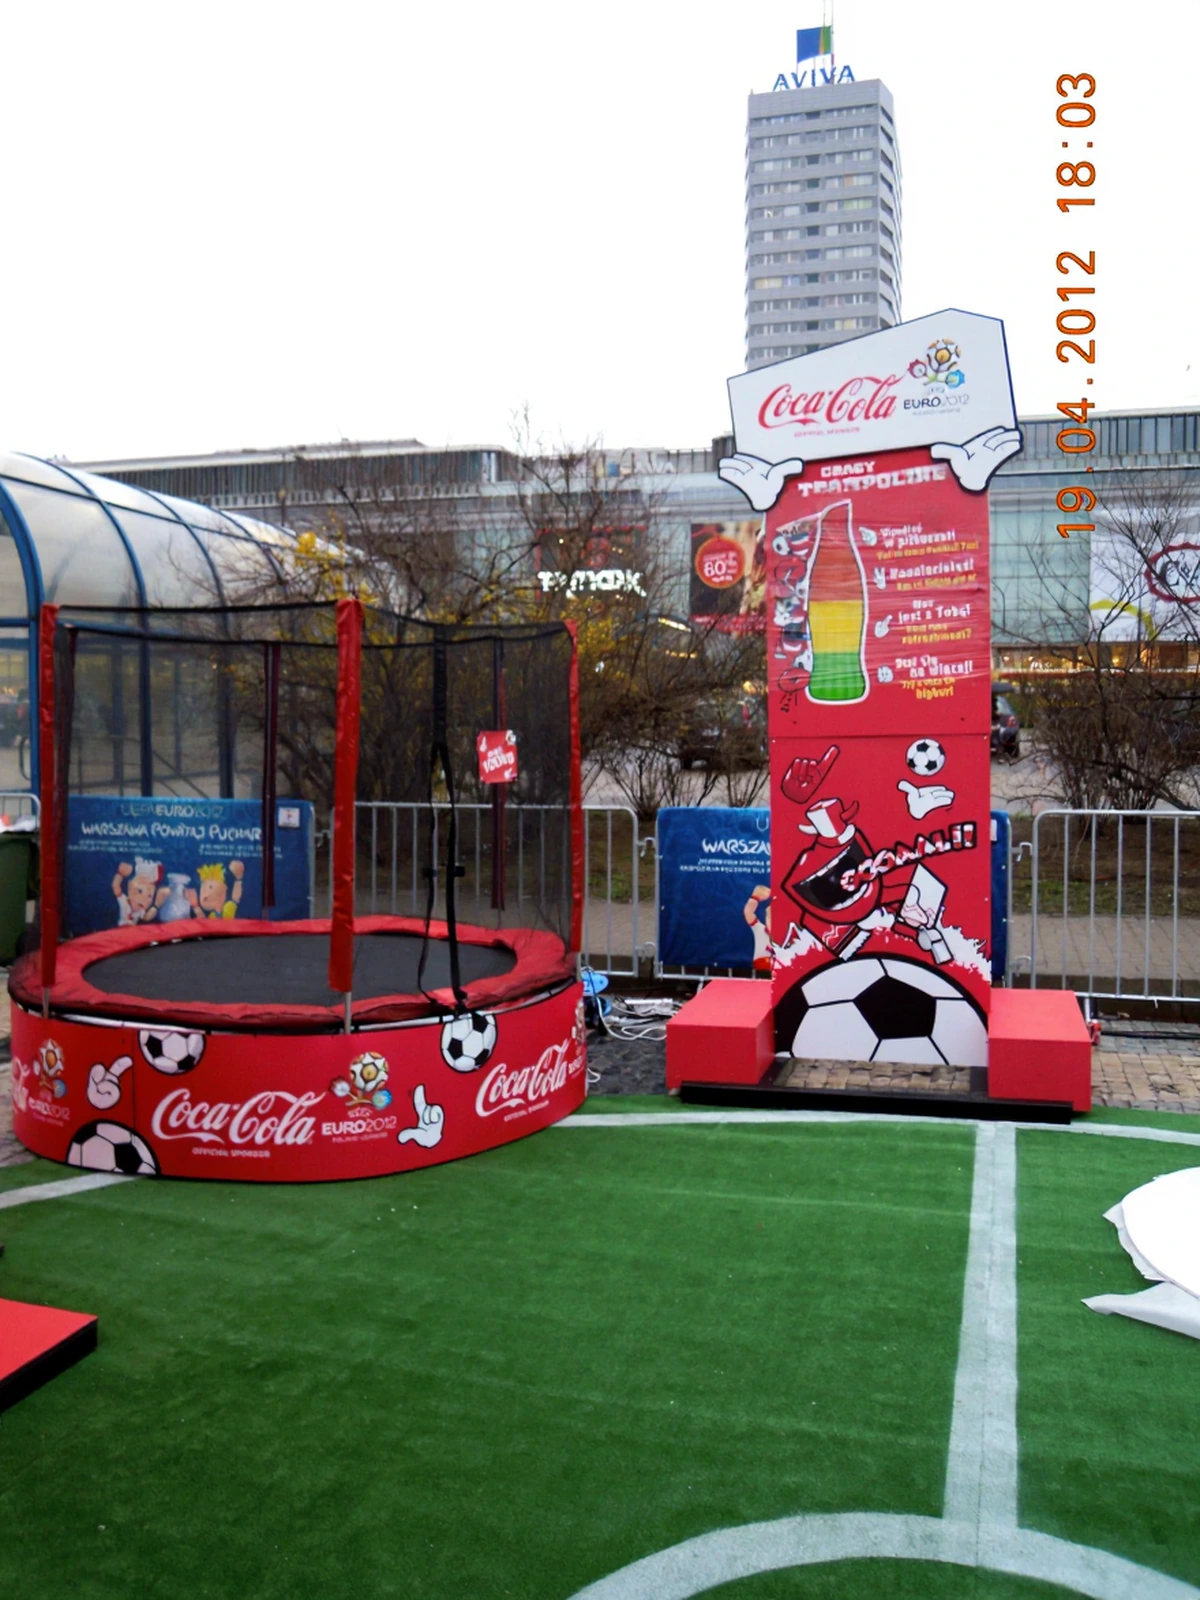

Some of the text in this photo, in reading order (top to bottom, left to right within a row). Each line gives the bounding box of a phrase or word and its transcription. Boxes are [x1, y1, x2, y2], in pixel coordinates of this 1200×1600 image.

[773, 65, 855, 91] AVIVA
[758, 373, 908, 429] Coca-Cola
[798, 464, 948, 498] TRAMPOLINE
[81, 821, 262, 841] WARSZAWA POWITAJ PUCHAR
[475, 1038, 571, 1118] Coca-Cola
[151, 1087, 327, 1146] Coca-Cola
